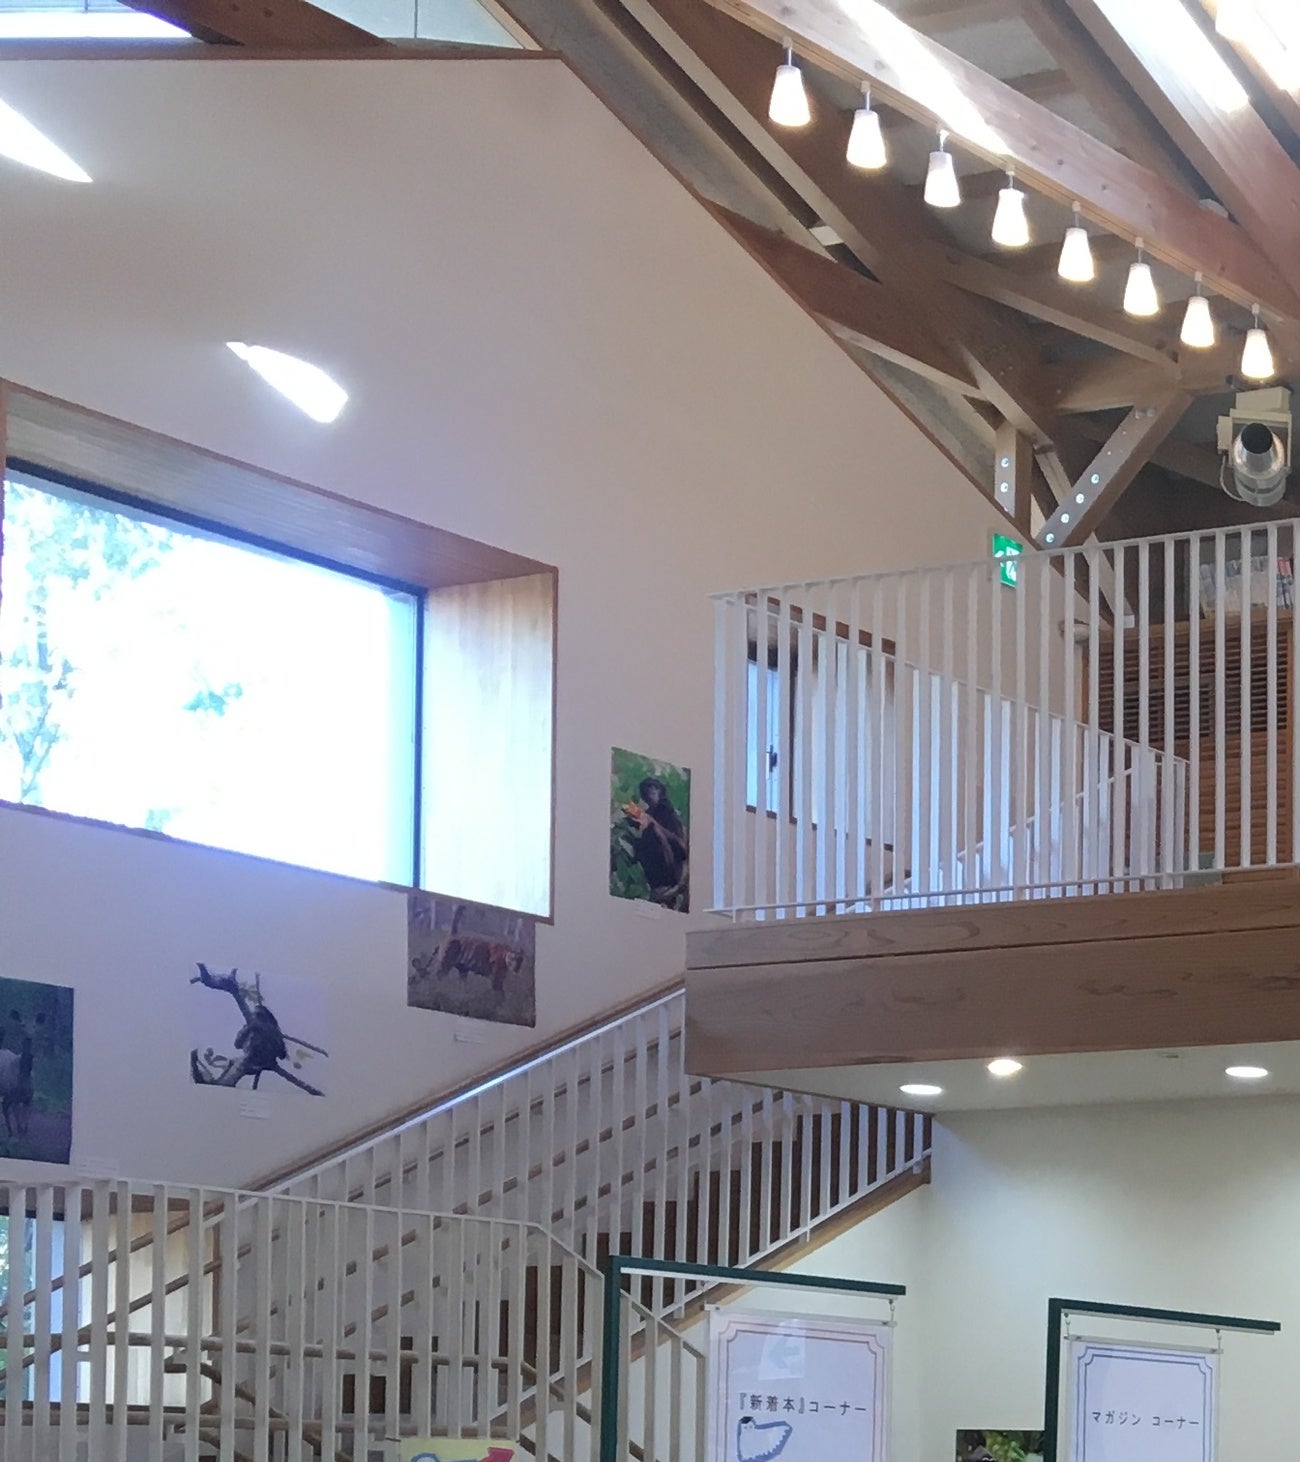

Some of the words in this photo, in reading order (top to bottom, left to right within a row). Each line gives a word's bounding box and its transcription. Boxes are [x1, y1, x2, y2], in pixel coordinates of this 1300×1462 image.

[1091, 1410, 1142, 1426] マガジン
[1152, 1416, 1200, 1430] コーナー
